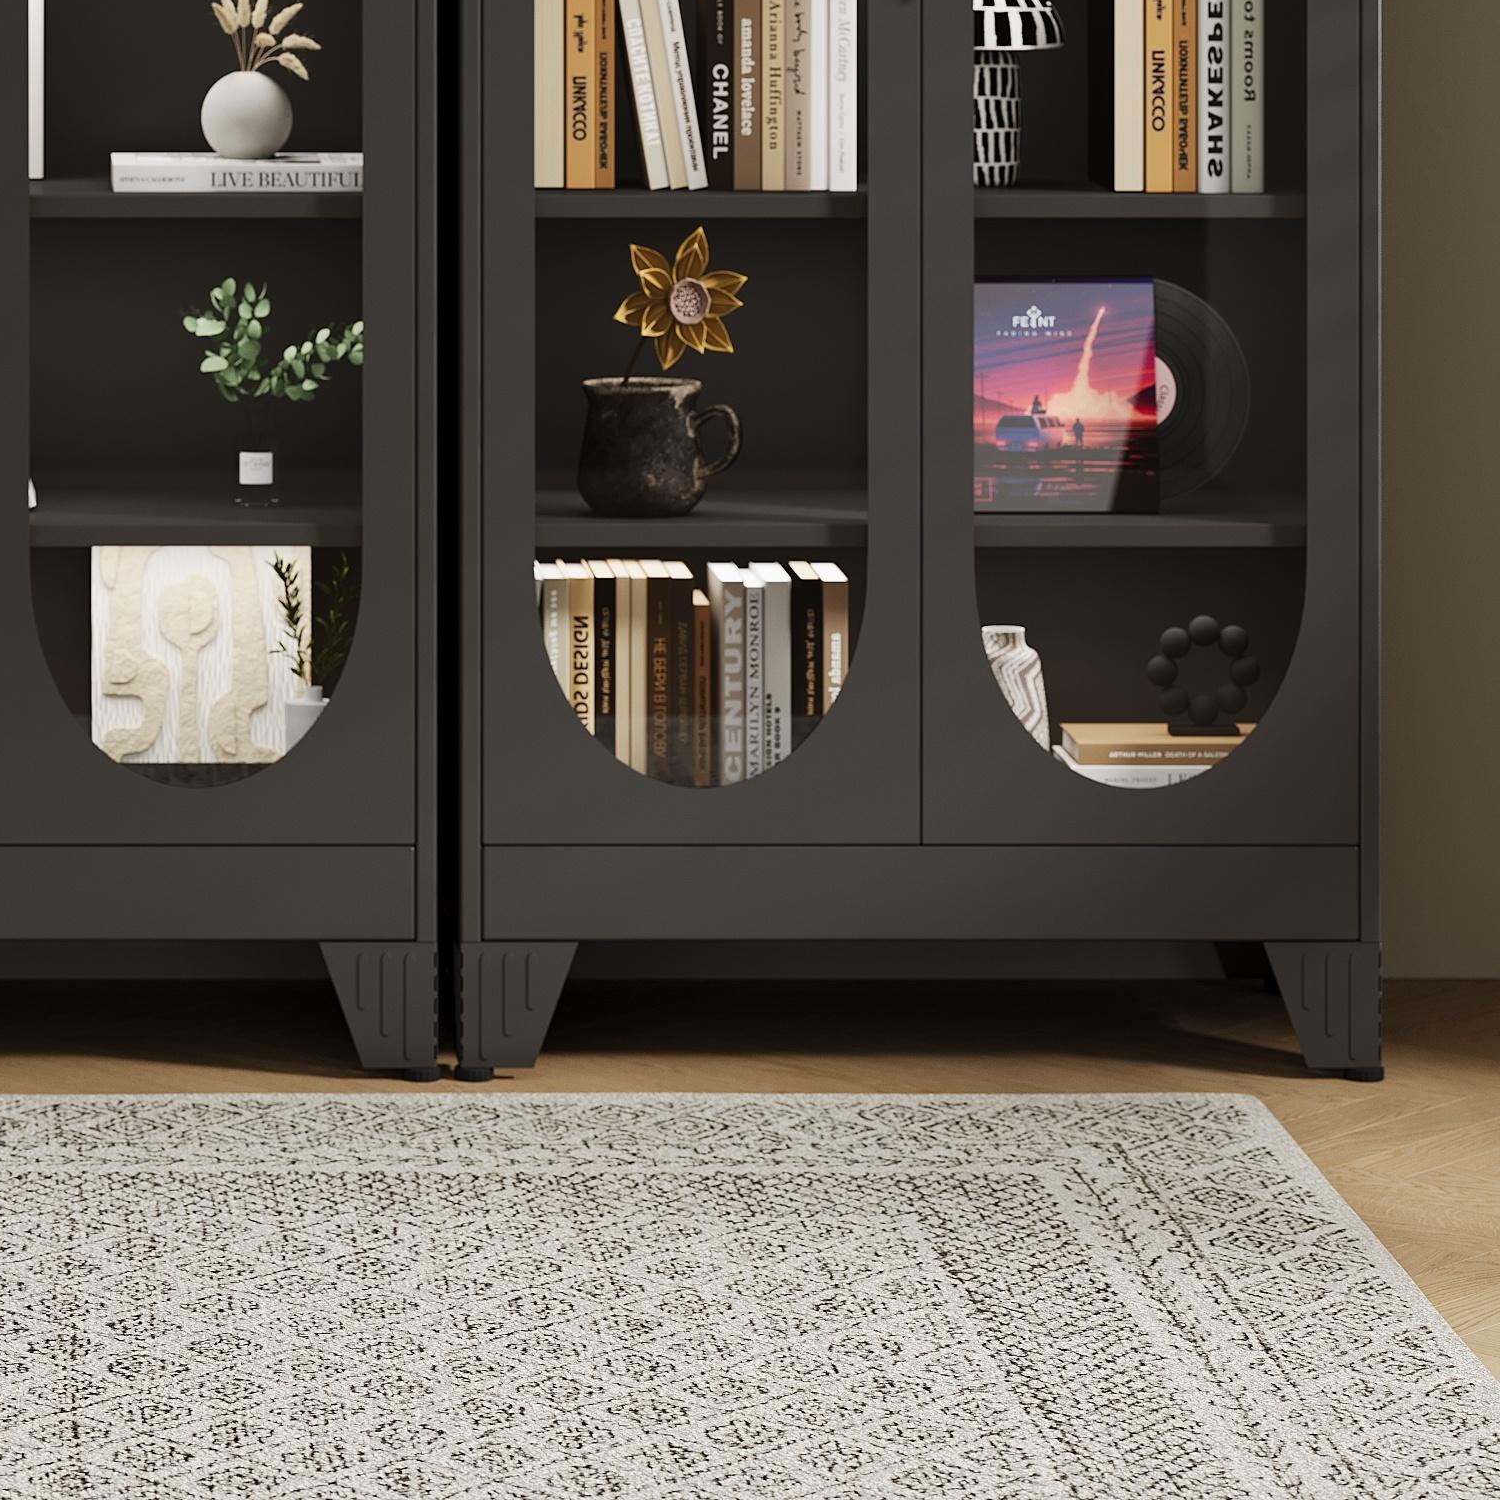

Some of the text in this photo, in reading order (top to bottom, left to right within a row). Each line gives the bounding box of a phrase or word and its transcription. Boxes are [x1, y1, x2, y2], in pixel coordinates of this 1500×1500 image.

[740, 18, 755, 136] amanda lovelace
[766, 0, 782, 150] Arianna Huffington
[836, 19, 852, 83] McCartney
[712, 63, 730, 160] CHANEL
[211, 171, 254, 188] LIVE
[724, 590, 742, 782] CENTURY
[749, 591, 761, 777] MARILYN MONROE
